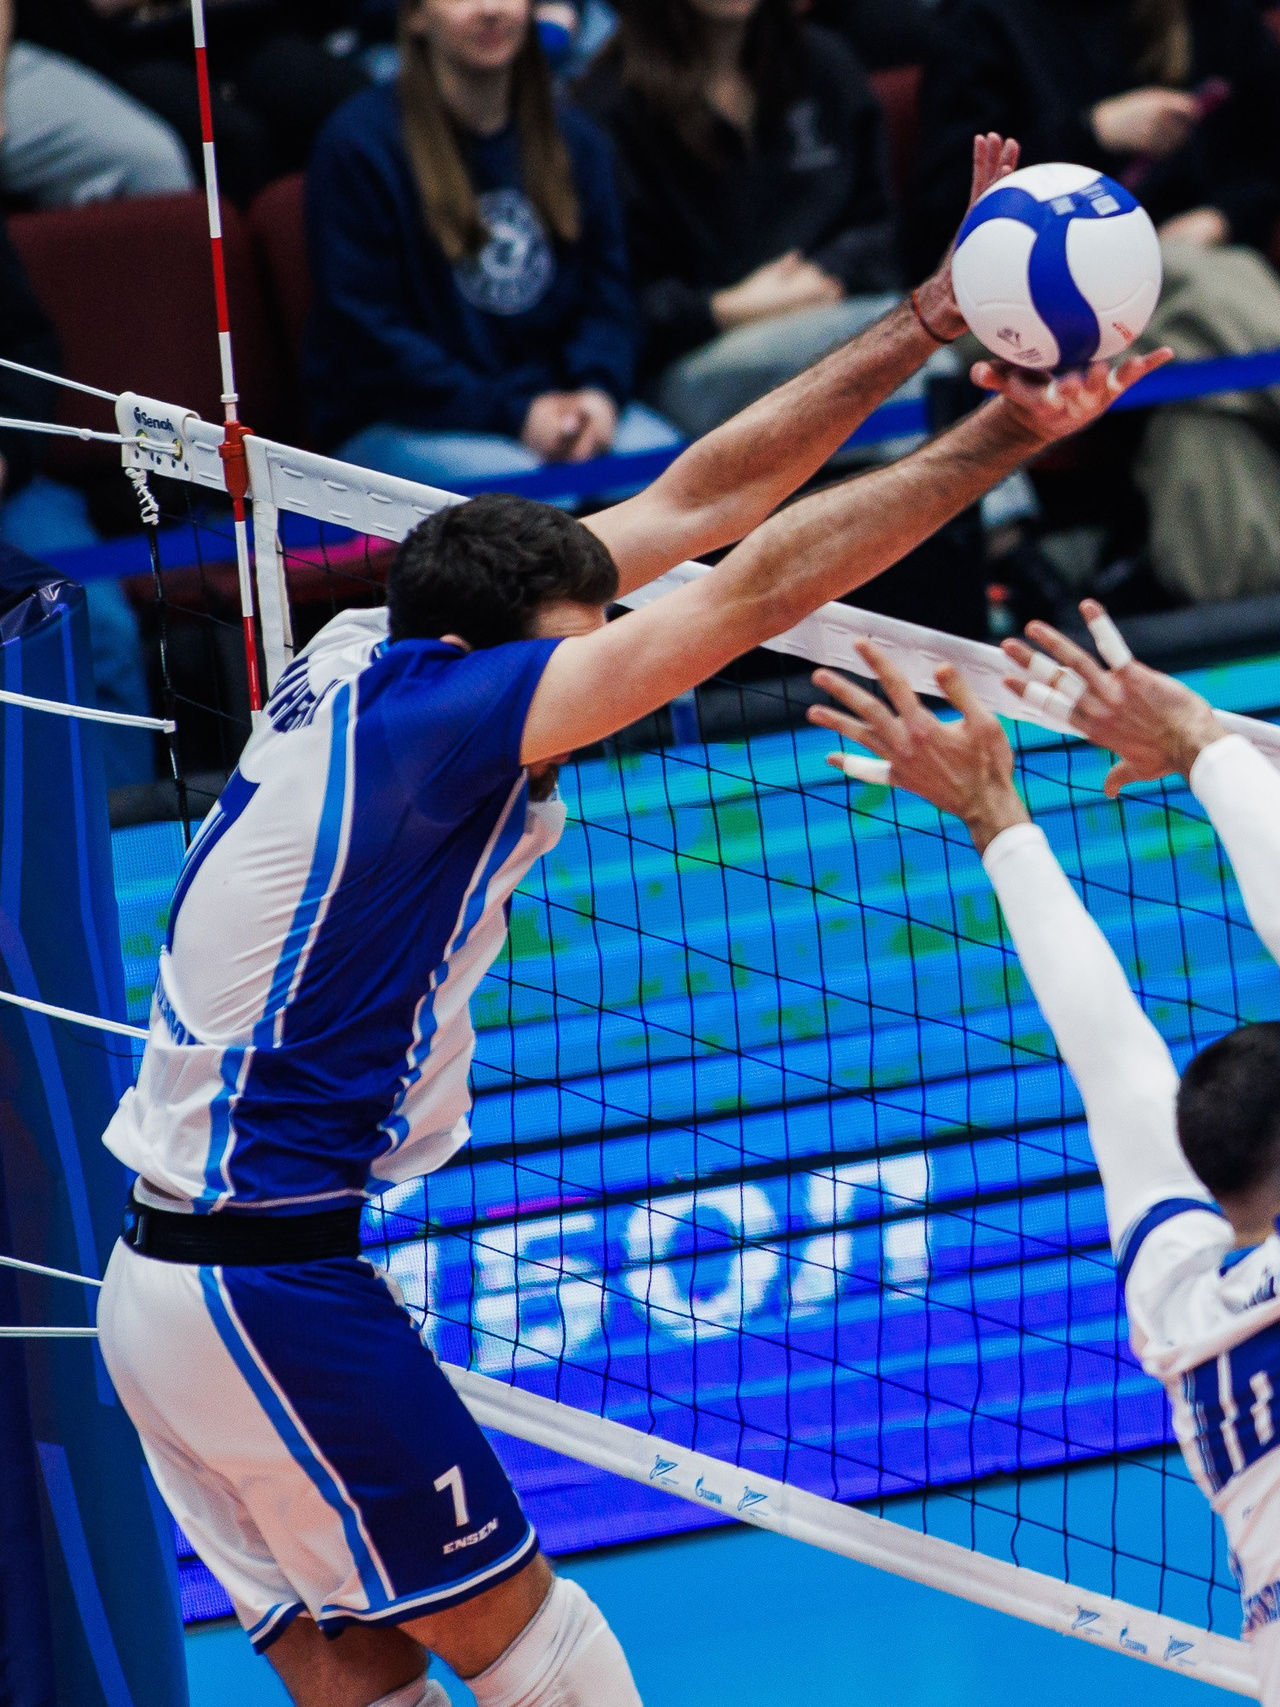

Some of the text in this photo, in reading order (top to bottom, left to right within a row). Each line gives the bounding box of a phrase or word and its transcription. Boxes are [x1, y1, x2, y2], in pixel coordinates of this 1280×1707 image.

[142, 411, 175, 432] Senoh
[433, 1465, 469, 1527] 7
[443, 1517, 499, 1555] ENSEN
